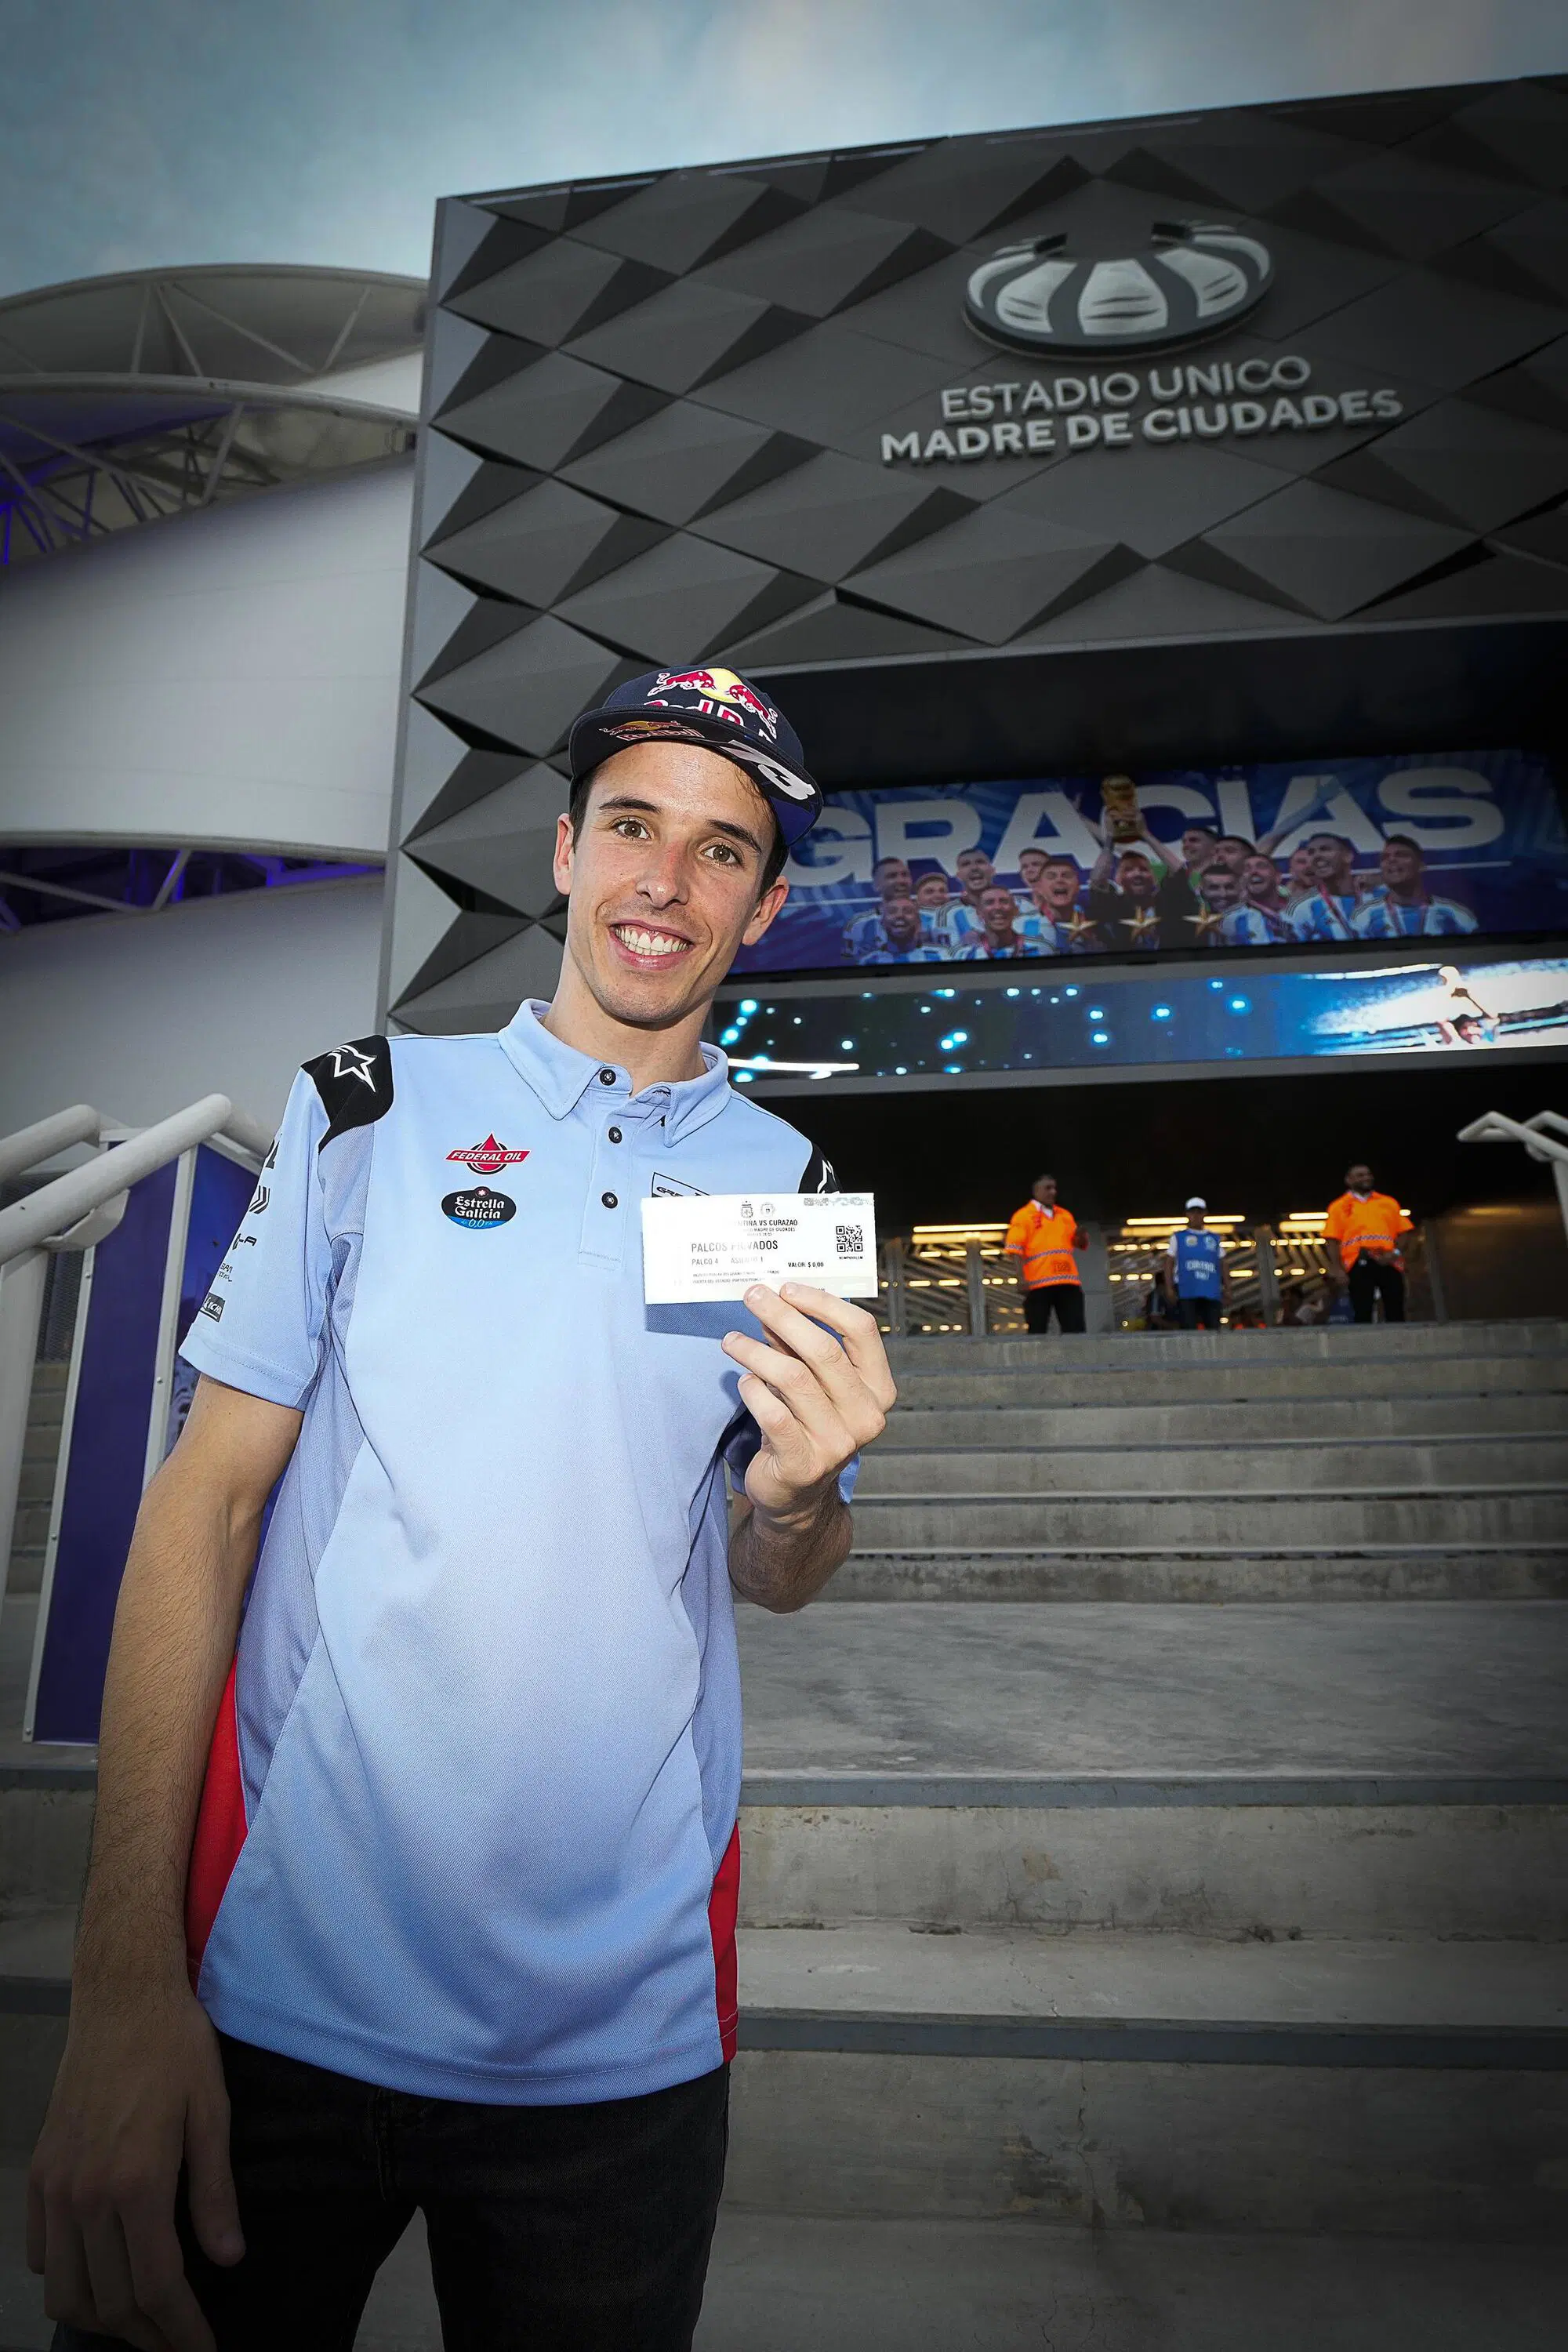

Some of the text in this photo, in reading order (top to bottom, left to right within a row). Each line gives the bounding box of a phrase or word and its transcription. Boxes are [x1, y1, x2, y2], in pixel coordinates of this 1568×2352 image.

[941, 355, 1312, 423] ESTADIO UNICO
[880, 390, 1404, 463] MADRE DE CIUDADES
[786, 765, 1505, 887] GRACIAS
[451, 1152, 523, 1161] FEDERAL OIL
[455, 1196, 505, 1209] Estrella
[455, 1206, 501, 1219] Galicia
[691, 1242, 728, 1253] PALCOS
